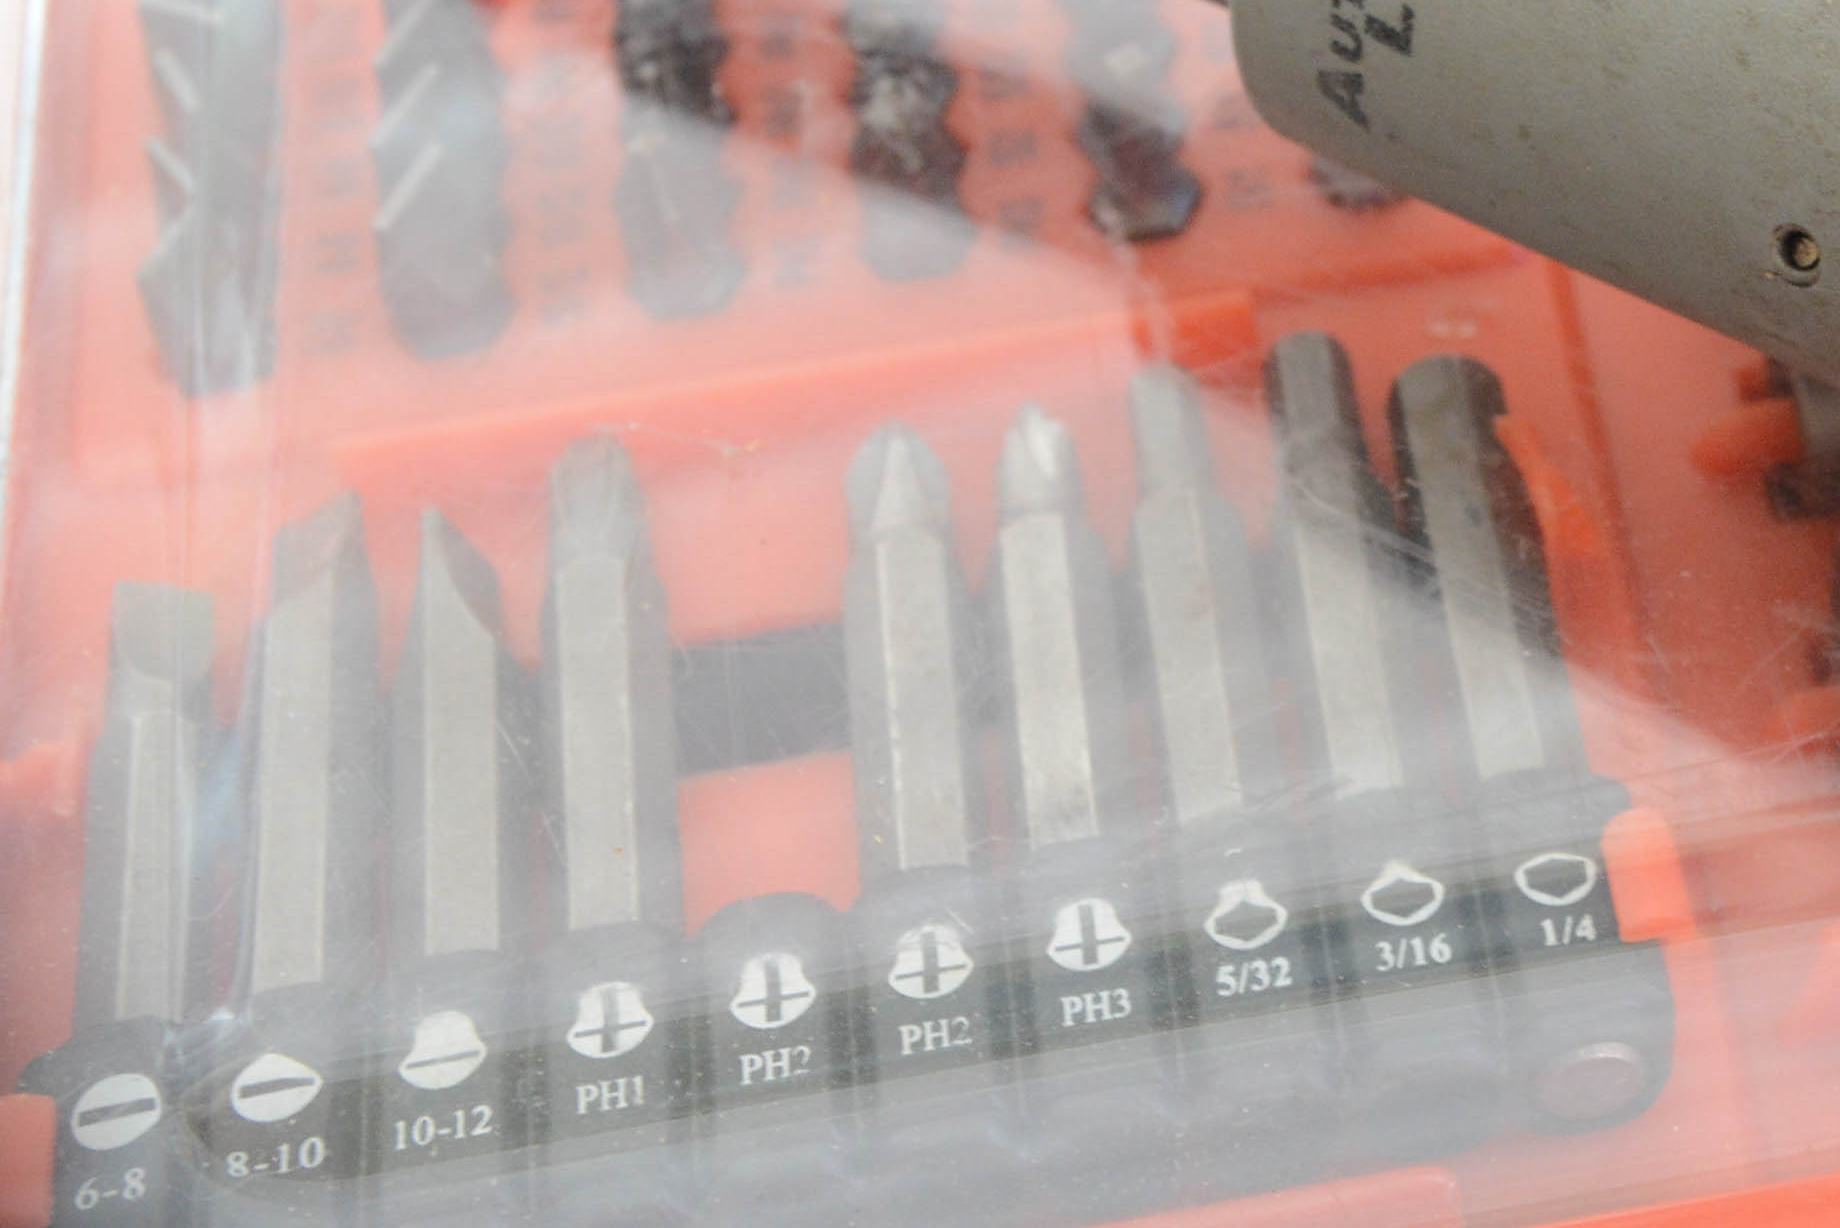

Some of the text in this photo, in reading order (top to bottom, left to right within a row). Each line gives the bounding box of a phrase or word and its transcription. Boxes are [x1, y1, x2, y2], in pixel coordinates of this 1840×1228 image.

[1539, 914, 1597, 947] 1/4
[1374, 933, 1452, 972] 3/16
[1215, 956, 1293, 998] 5/32
[1060, 987, 1132, 1028] PH3
[899, 1017, 974, 1056] PH2
[739, 1045, 812, 1087] PH2
[575, 1075, 647, 1116] PH1
[392, 1104, 495, 1152] 10-12
[225, 1136, 326, 1179] 8-10
[74, 1167, 148, 1211] 6-8
